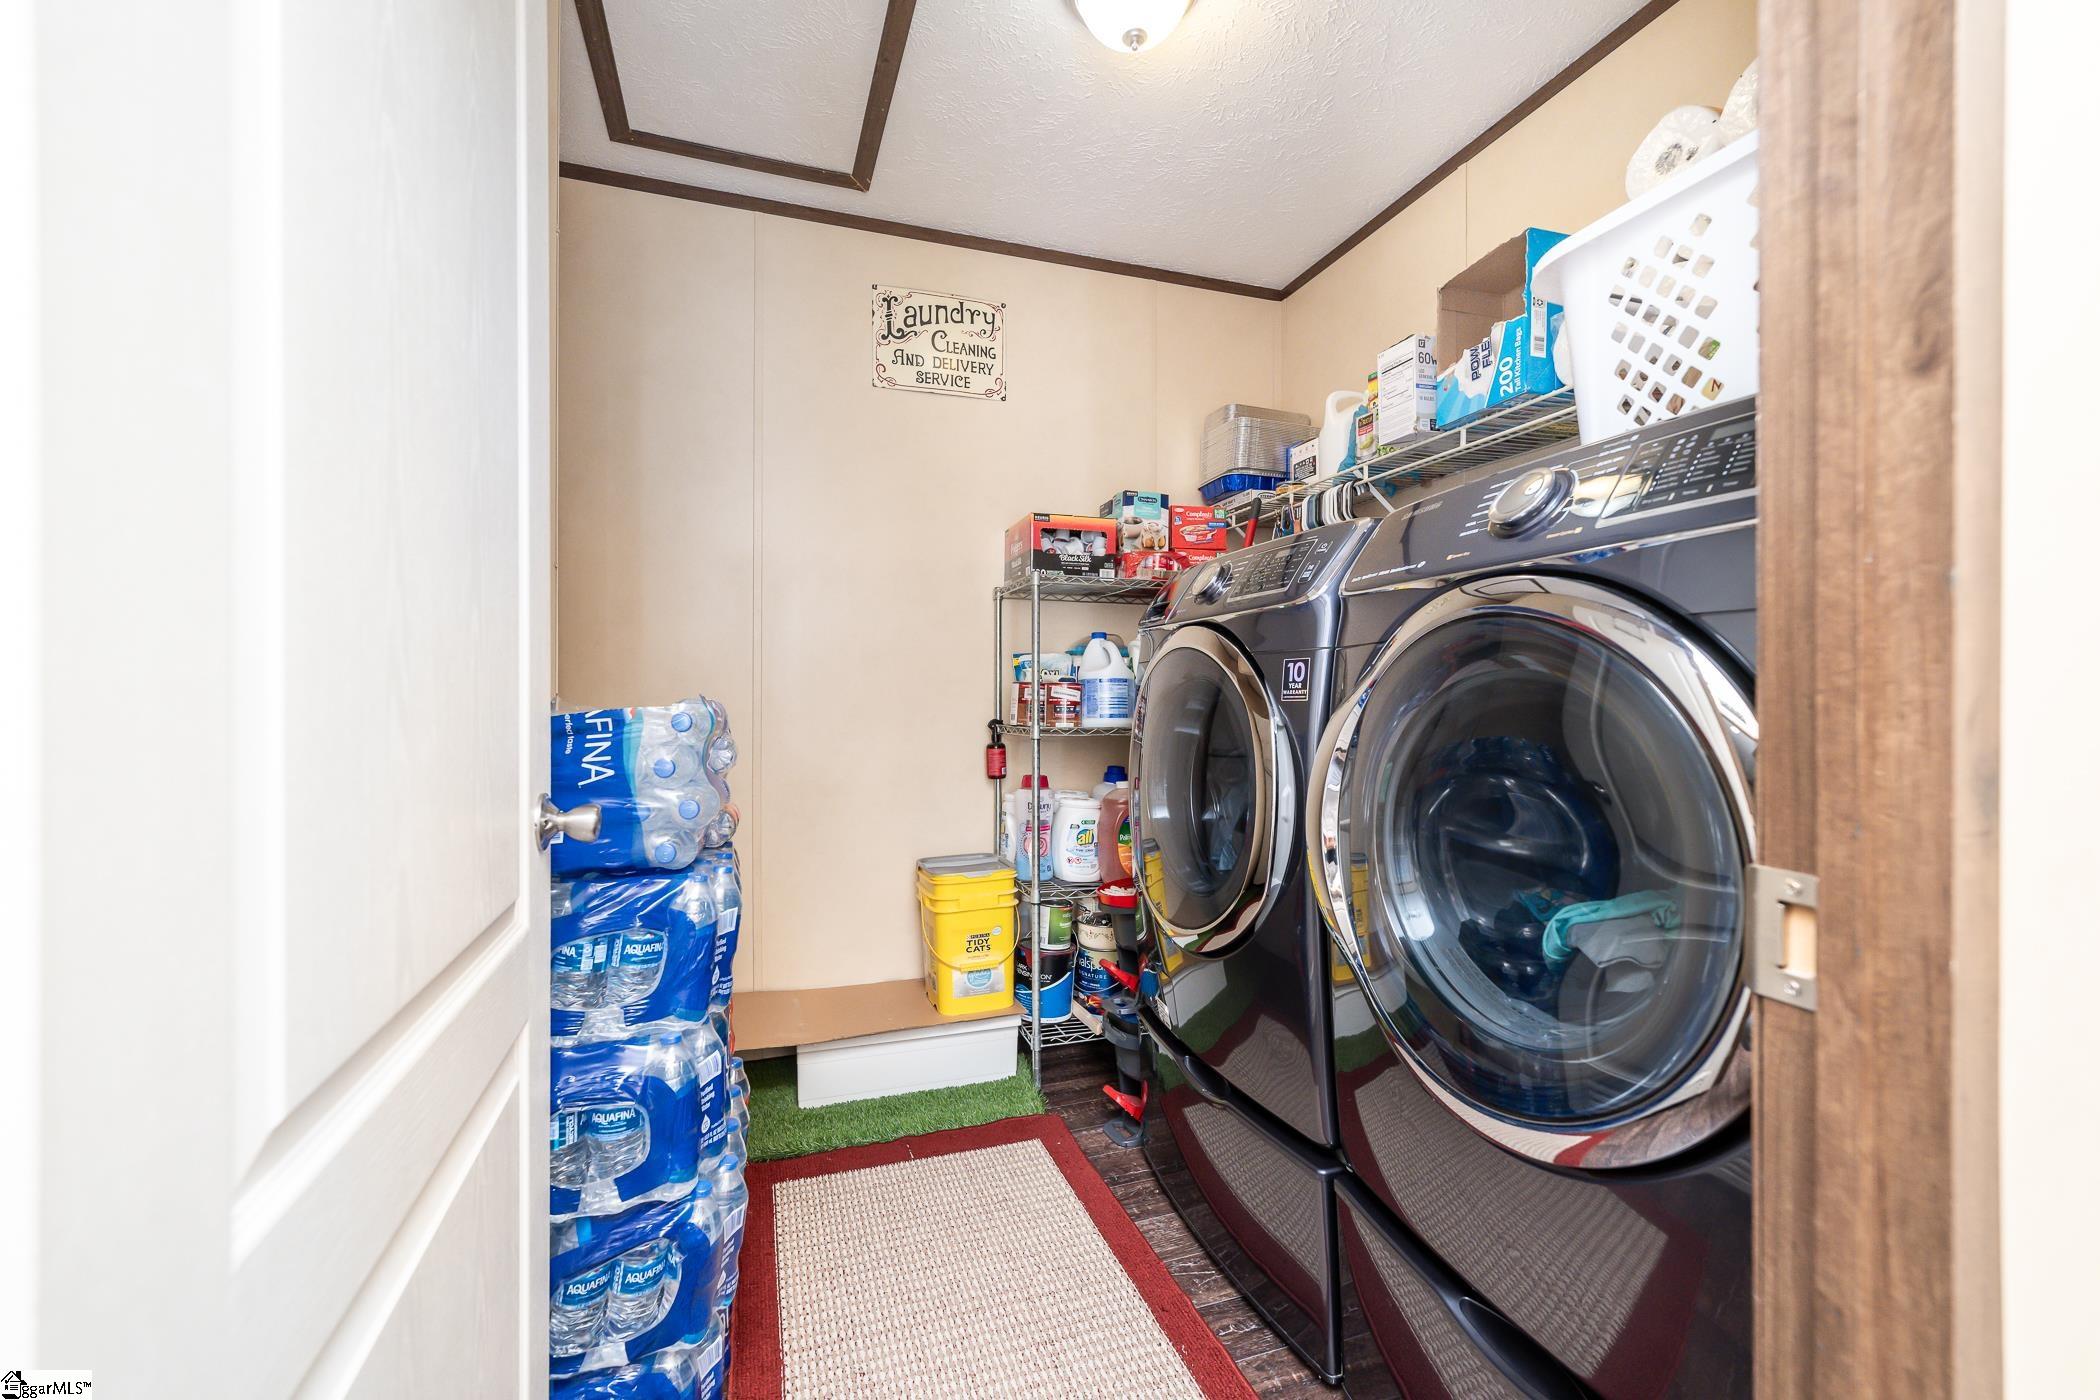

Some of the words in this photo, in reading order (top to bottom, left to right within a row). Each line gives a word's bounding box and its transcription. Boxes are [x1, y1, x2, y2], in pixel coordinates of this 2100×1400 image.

[880, 294, 995, 340] Laundry
[1515, 327, 1523, 347] Bags
[892, 349, 925, 367] AND
[933, 356, 994, 376] DELIVERY
[1514, 347, 1522, 376] Kitchen
[916, 370, 971, 389] SERVICE
[1499, 356, 1514, 397] 200
[1287, 661, 1305, 682] 10
[1077, 828, 1094, 846] all
[965, 944, 991, 953] CATS
[966, 937, 990, 947] TIDY
[591, 1107, 636, 1126] AQUAFINA
